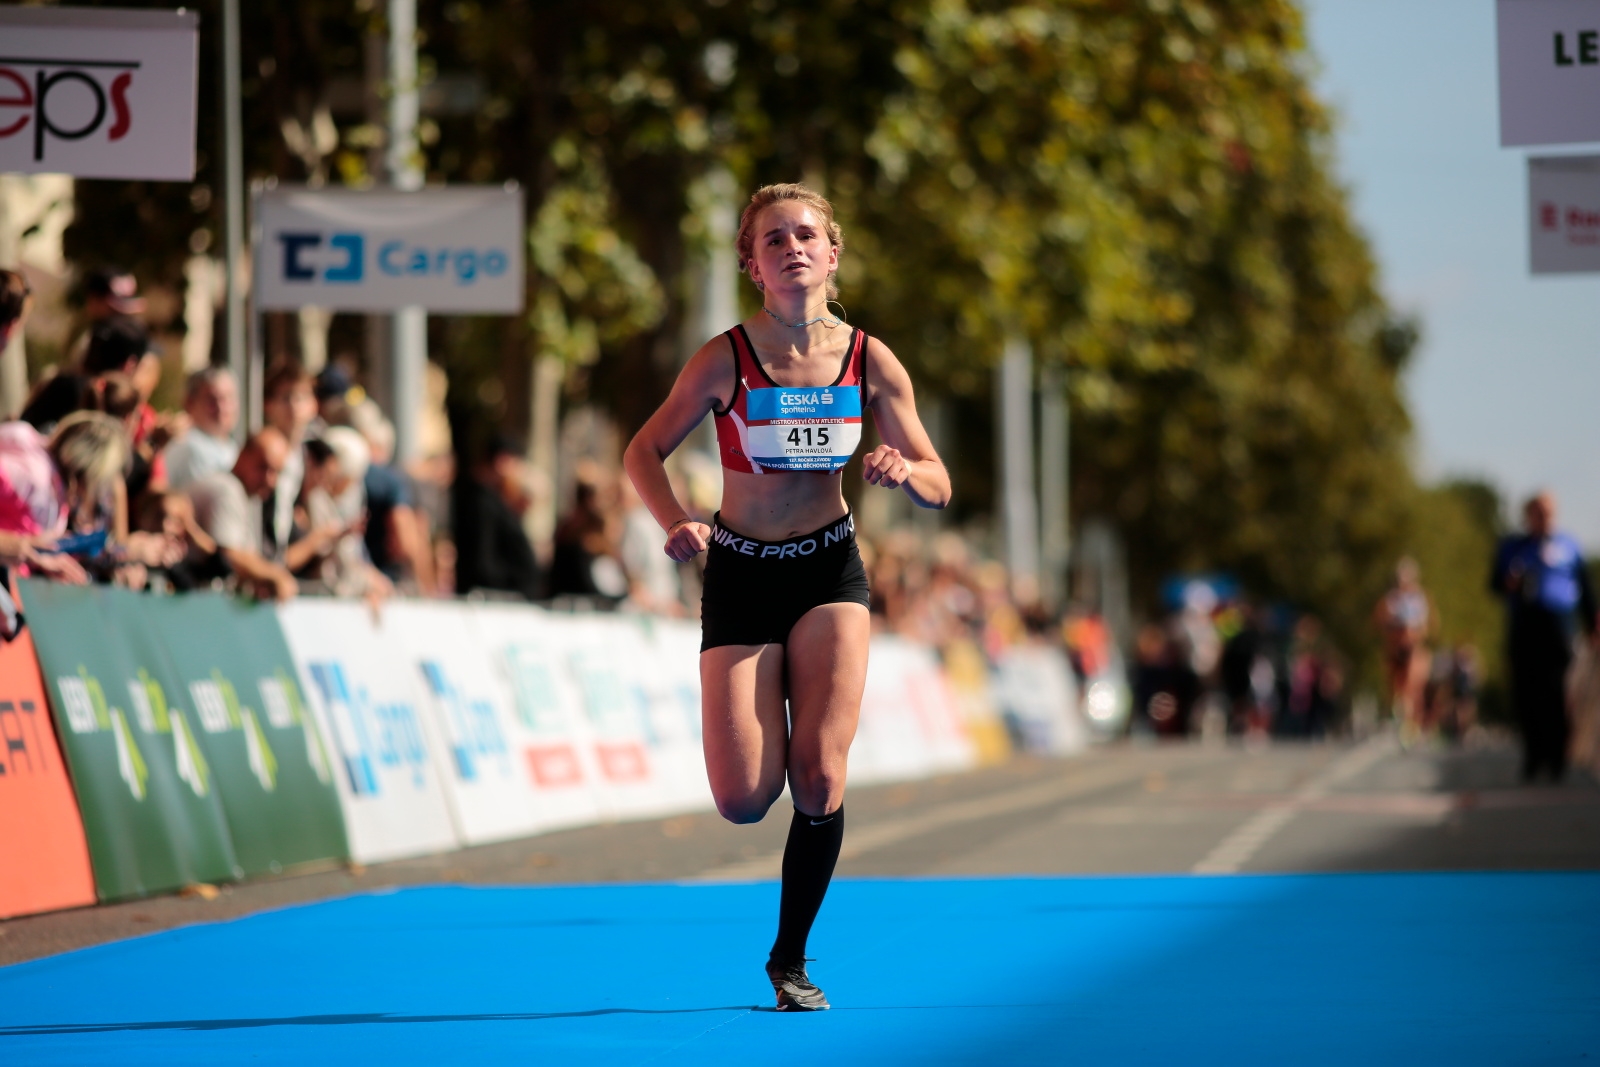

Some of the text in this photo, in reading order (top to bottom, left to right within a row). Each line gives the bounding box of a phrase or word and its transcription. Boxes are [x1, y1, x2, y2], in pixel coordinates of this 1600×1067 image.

[377, 240, 508, 287] Cargo
[780, 391, 819, 406] ČESKÁ
[786, 427, 830, 447] 415
[711, 513, 854, 560] NIKE PRO NIK
[0, 700, 48, 774] AT
